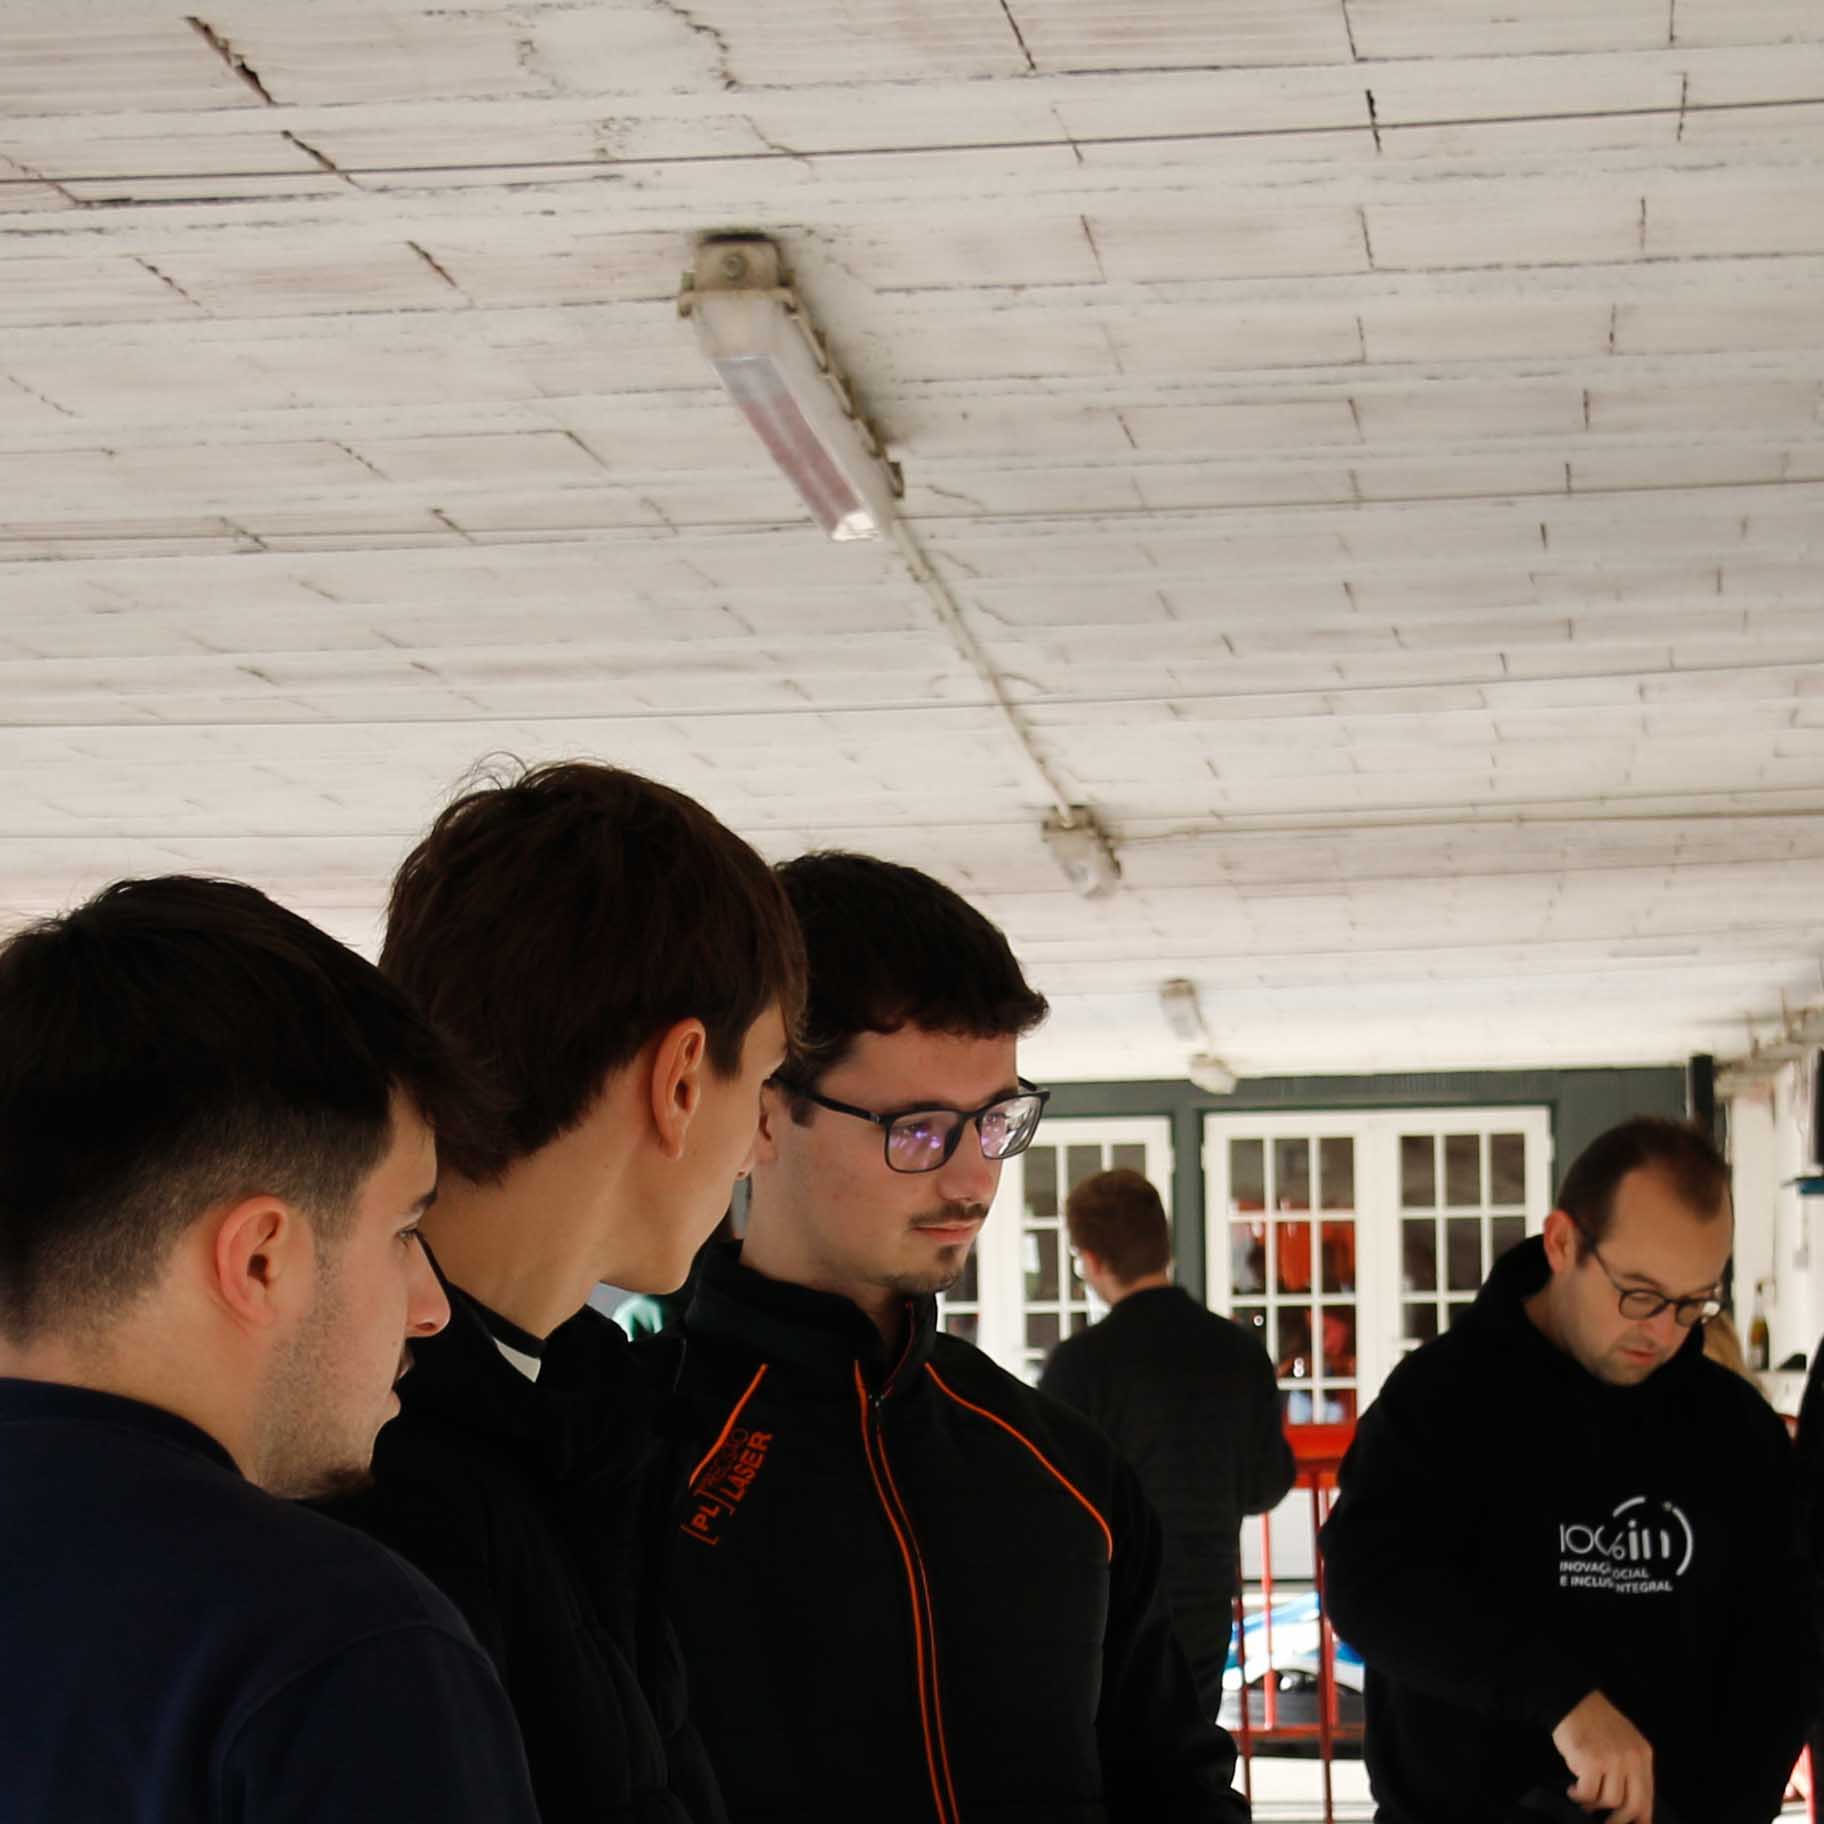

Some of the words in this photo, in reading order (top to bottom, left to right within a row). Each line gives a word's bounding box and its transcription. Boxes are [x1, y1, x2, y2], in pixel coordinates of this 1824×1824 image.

[720, 1431, 774, 1503] LASER
[1613, 1567, 1651, 1580] OCIAL
[1615, 1580, 1674, 1594] NTEGRAL
